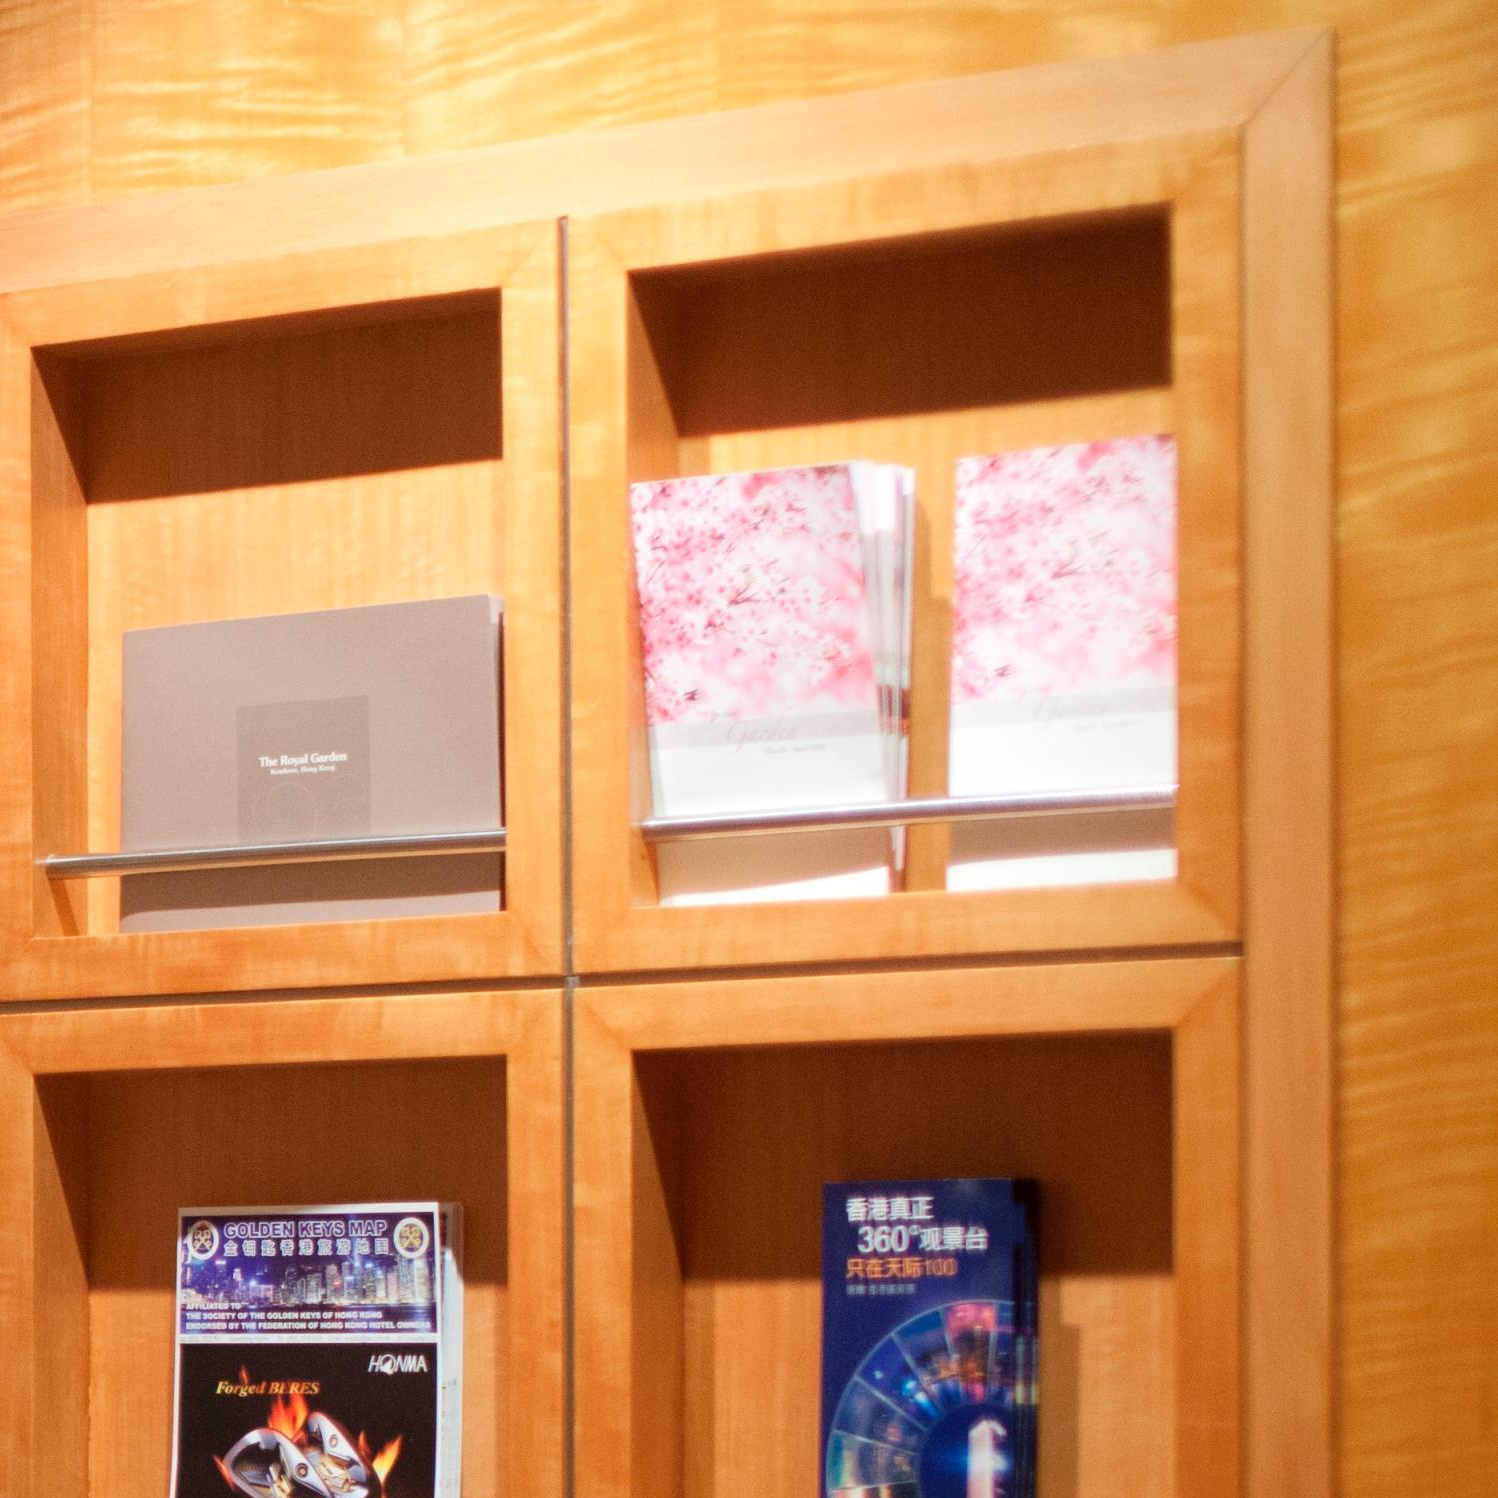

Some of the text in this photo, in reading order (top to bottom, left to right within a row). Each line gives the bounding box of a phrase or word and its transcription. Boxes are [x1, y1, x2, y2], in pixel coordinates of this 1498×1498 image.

[258, 752, 348, 767] The Royal Garden
[846, 1196, 935, 1222] 香港真正
[224, 1220, 387, 1239] GOLDEN KEYS MAP
[857, 1225, 989, 1253] 360°观景台
[846, 1257, 958, 1278] 只在天际100
[367, 1354, 428, 1375] HONMA
[215, 1381, 320, 1397] Forged BERES
